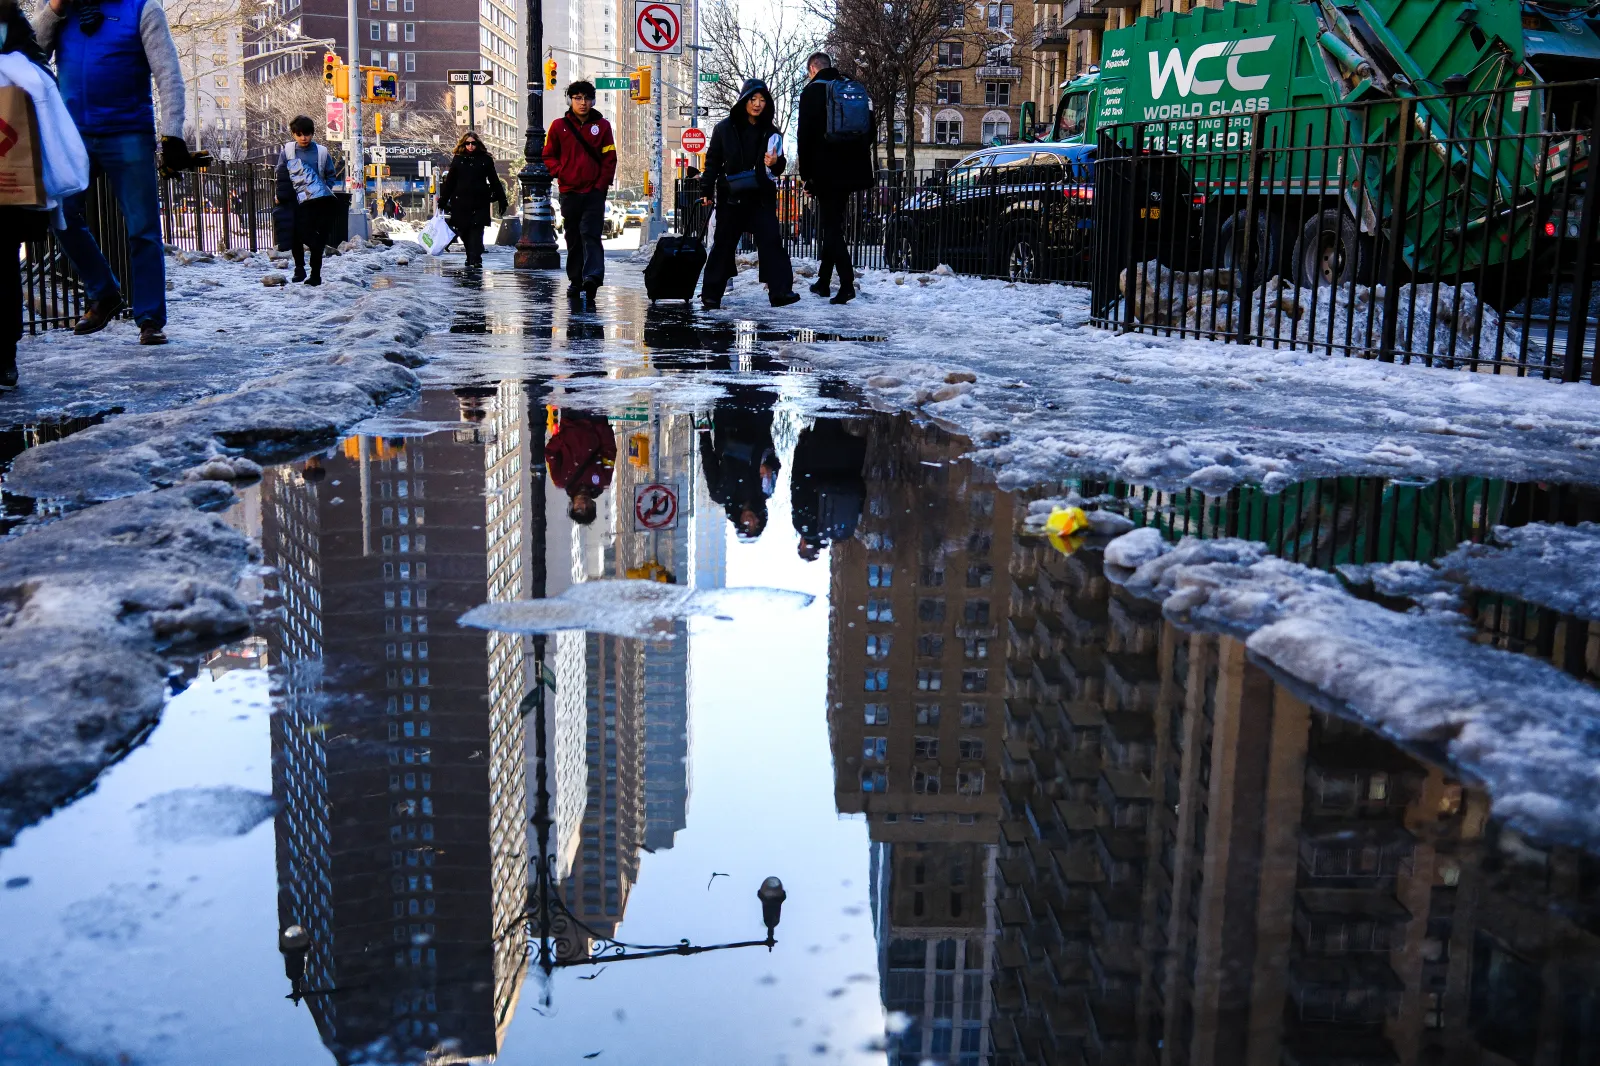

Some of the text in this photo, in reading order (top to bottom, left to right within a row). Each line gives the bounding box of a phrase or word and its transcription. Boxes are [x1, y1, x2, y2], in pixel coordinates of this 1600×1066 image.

[1149, 35, 1276, 100] WCC
[608, 80, 628, 88] W 71
[1143, 97, 1270, 120] WORLD CLASS
[1144, 119, 1221, 132] ONRACING
[1143, 131, 1253, 150] 718-784-503
